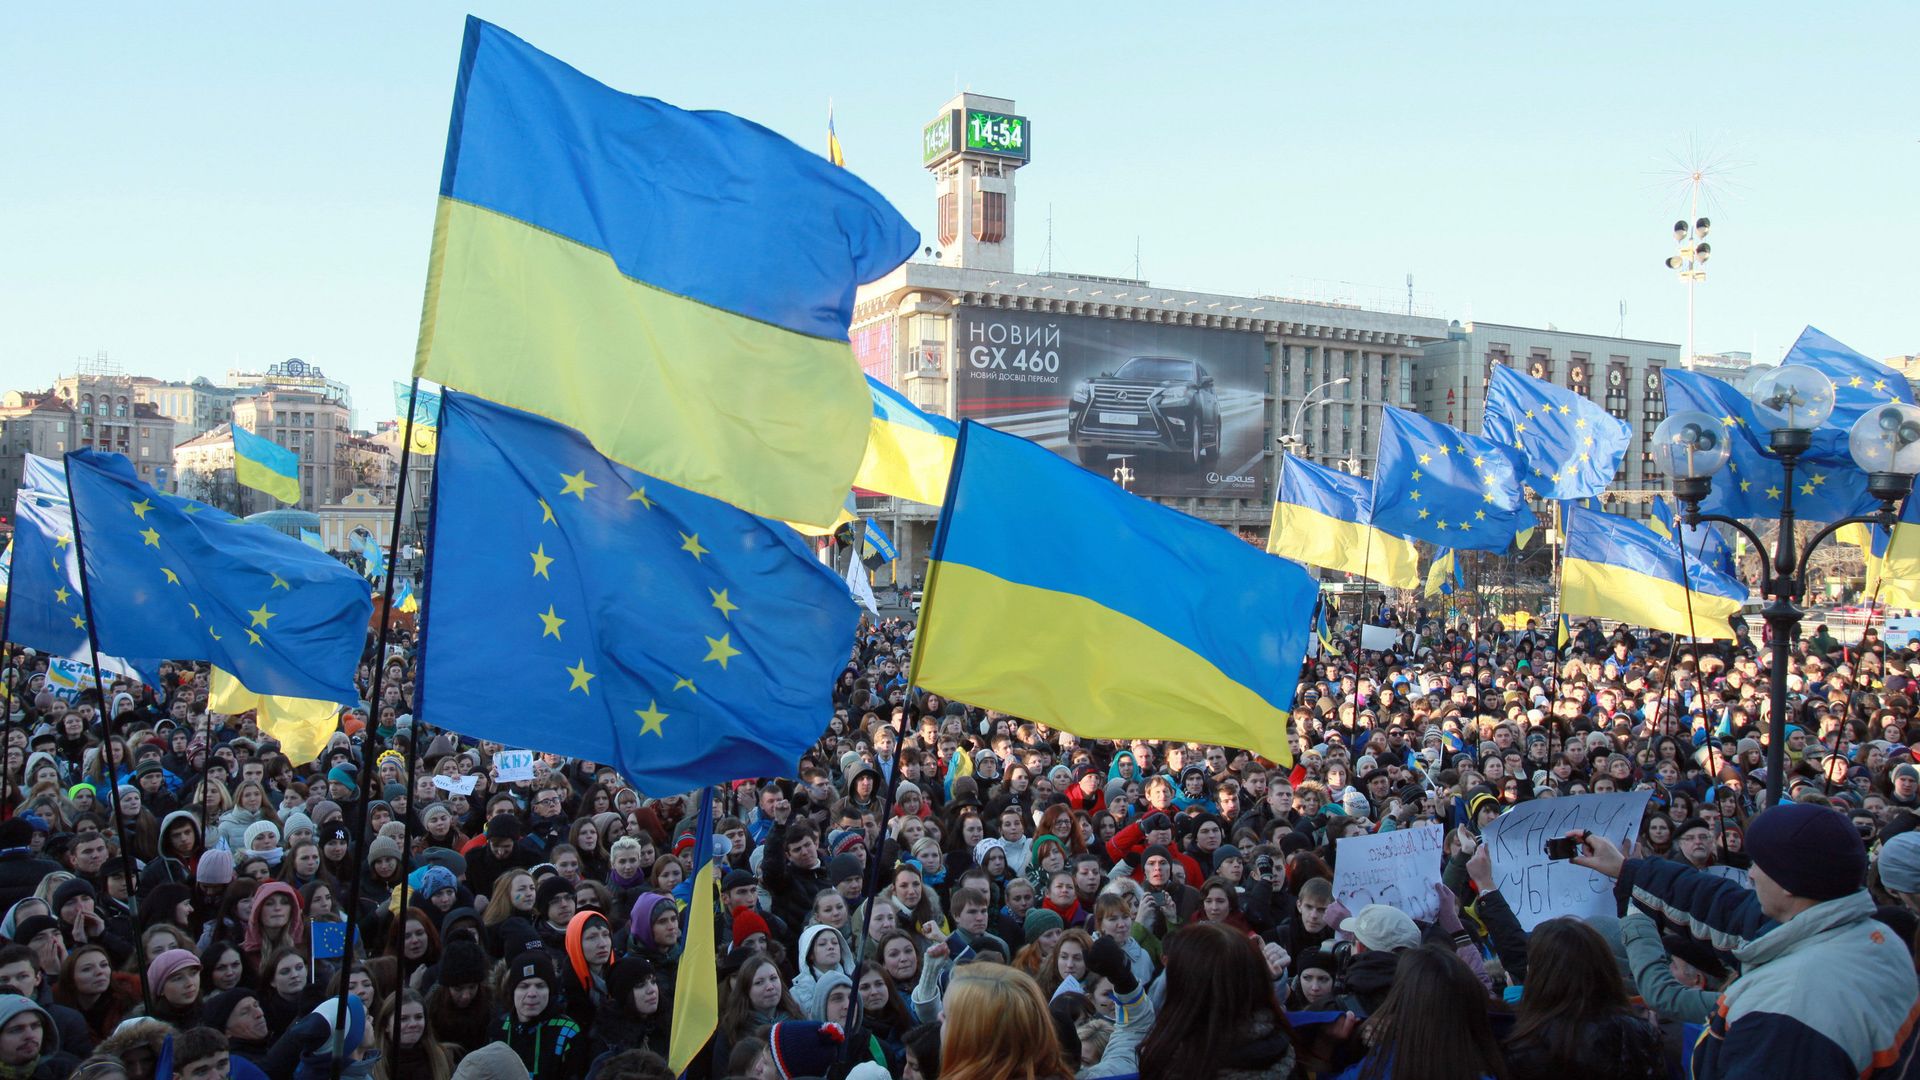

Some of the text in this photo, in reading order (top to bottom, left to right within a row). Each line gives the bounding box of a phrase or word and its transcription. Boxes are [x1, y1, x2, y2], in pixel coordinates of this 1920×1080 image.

[925, 120, 949, 154] 14:54
[971, 119, 1022, 147] 14:54
[970, 321, 1060, 348] НОВИЙ
[970, 345, 1059, 373] GX 460
[970, 371, 1059, 384] НОВИЙ ДОСВІД ПЕРЕМОГ
[1220, 475, 1255, 483] LEXUS
